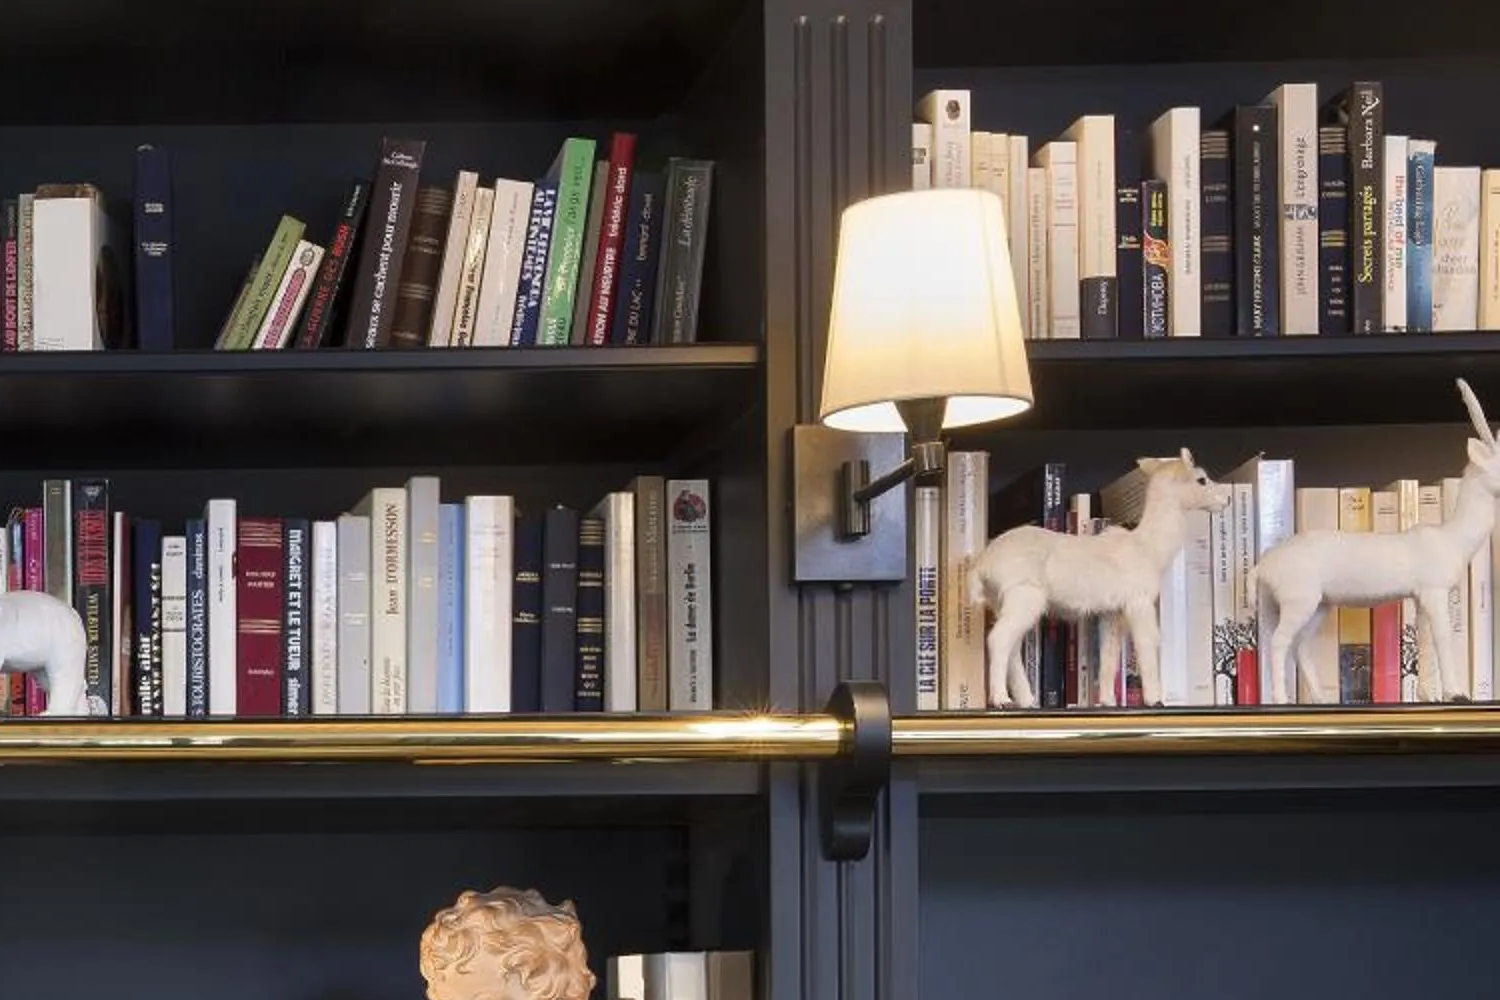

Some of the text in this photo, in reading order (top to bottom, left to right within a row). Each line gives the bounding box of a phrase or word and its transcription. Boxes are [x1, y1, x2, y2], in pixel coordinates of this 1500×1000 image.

[1361, 89, 1379, 169] Barbara Neil
[1394, 174, 1405, 196] the
[1395, 199, 1406, 228] best
[381, 223, 395, 254] pour
[1357, 185, 1377, 283] Secrets partagés
[1395, 231, 1406, 245] of
[373, 251, 391, 299] cachent
[5, 283, 17, 297] DE
[371, 299, 382, 314] se
[1253, 304, 1262, 329] MARY
[365, 315, 380, 349] seaux
[288, 529, 302, 589] MAIGRET
[384, 503, 398, 615] Jean D'ORMESSON
[288, 591, 302, 608] ET
[683, 591, 696, 603] de
[918, 566, 936, 606] PORTE
[288, 611, 302, 626] LE
[918, 608, 936, 623] LA
[288, 628, 302, 671] TUEUR
[918, 625, 936, 652] SUR
[87, 645, 100, 686] SMITH
[138, 675, 152, 715] mile
[918, 677, 936, 693] LA
